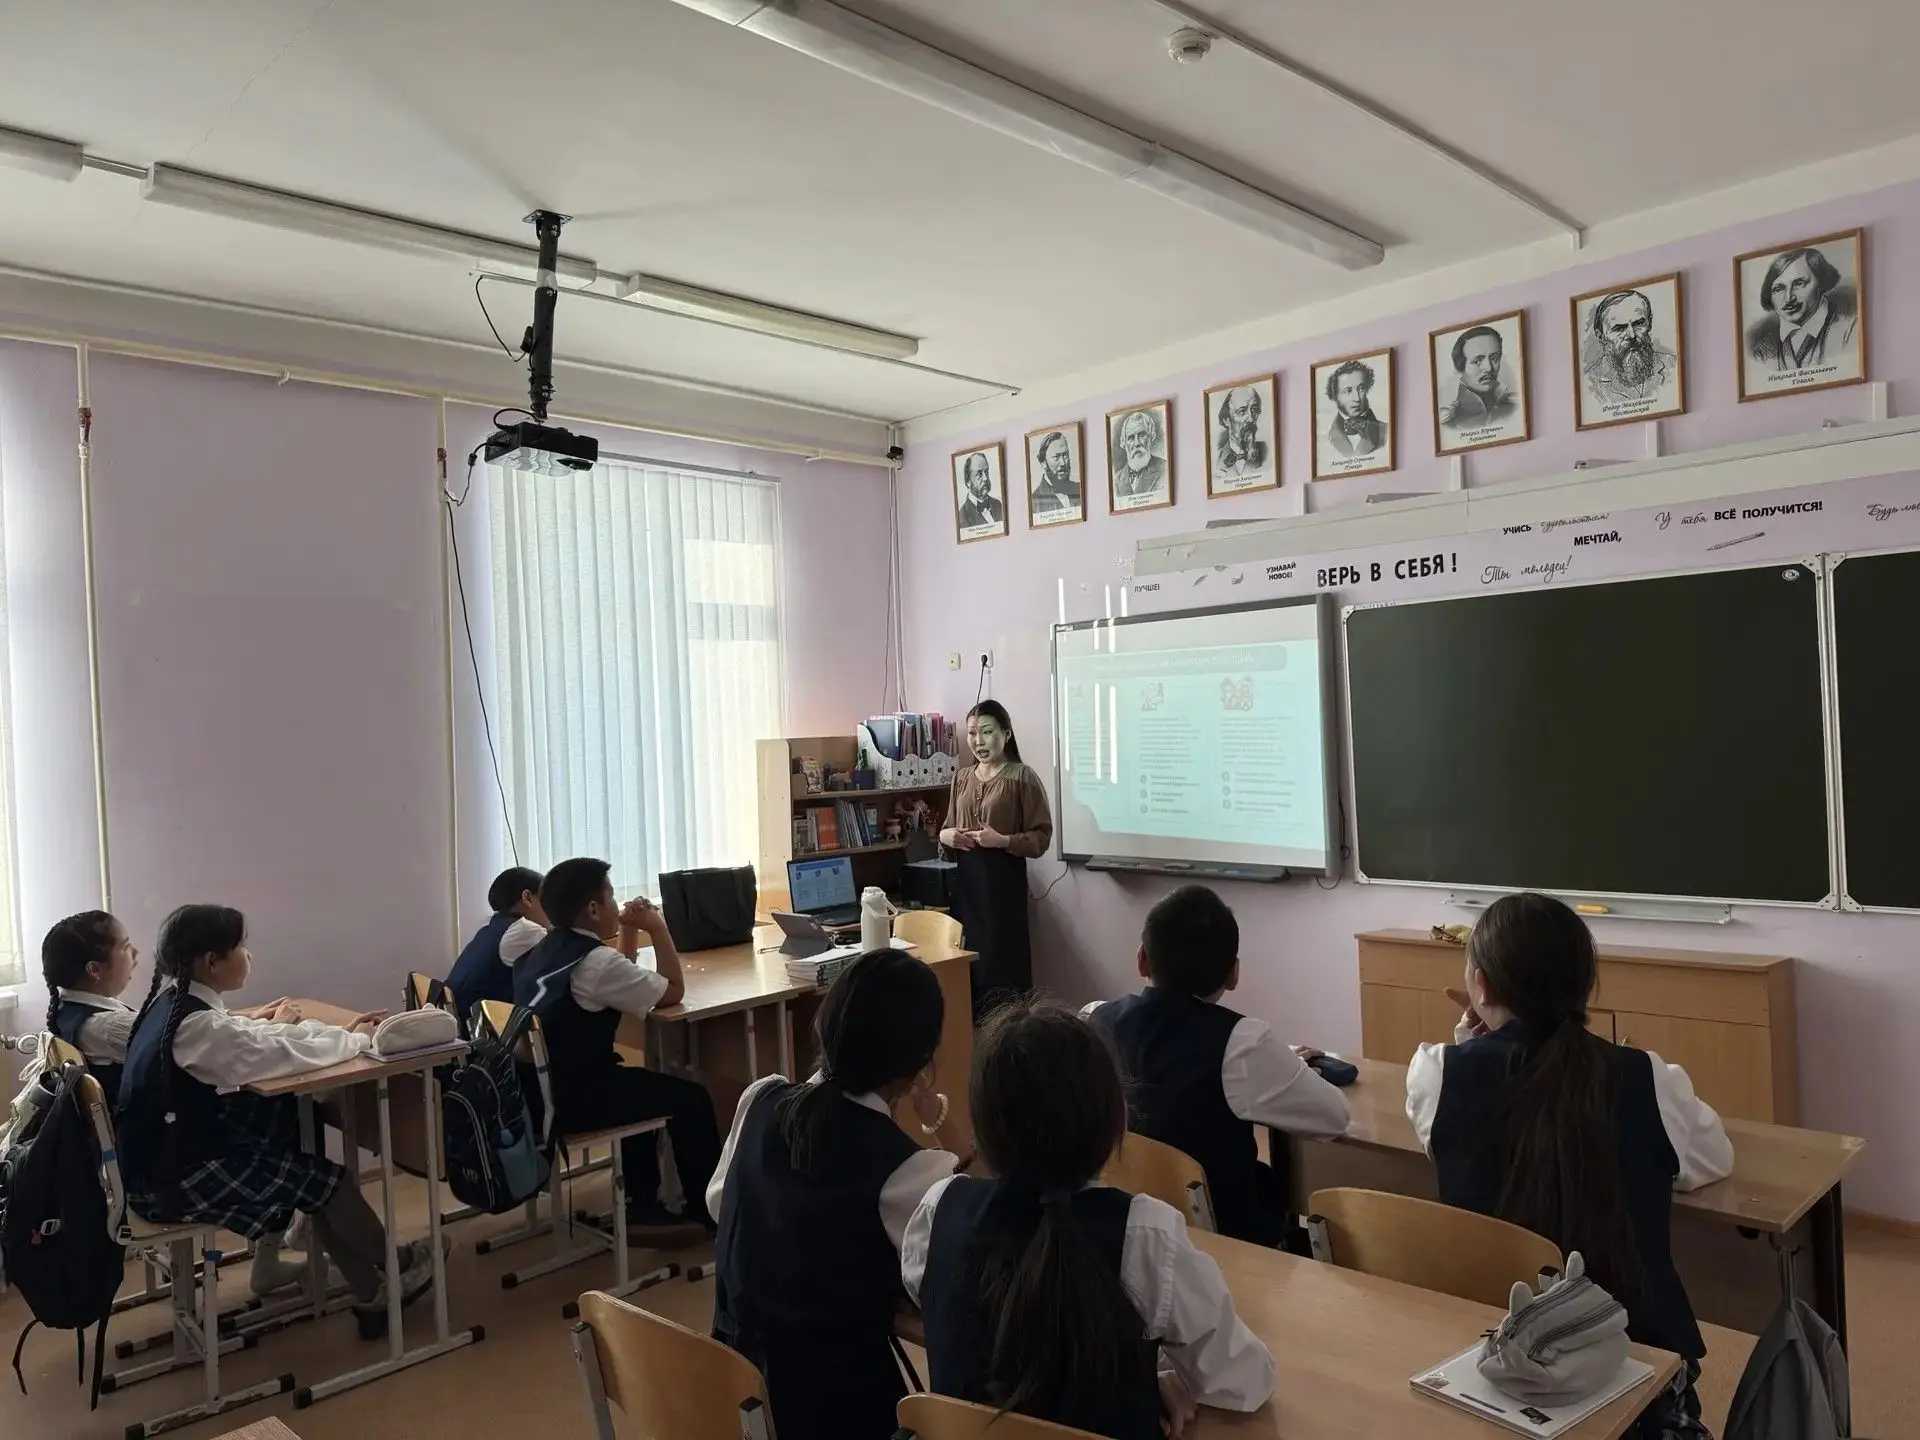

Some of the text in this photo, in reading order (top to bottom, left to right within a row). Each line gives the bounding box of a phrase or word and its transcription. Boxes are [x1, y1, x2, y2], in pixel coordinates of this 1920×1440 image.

[1714, 507, 1737, 521] ВСЁ
[1742, 500, 1824, 520] ПОЛУЧИТСЯ!
[1503, 524, 1532, 535] УЧИСЬ
[1573, 530, 1622, 546] МЕЧТАЙ,
[1266, 561, 1297, 575] УЗНАВАЙ
[1317, 565, 1361, 588] ВЕРЬ
[1370, 562, 1382, 582] В
[1268, 571, 1293, 581] НОВОЕ!
